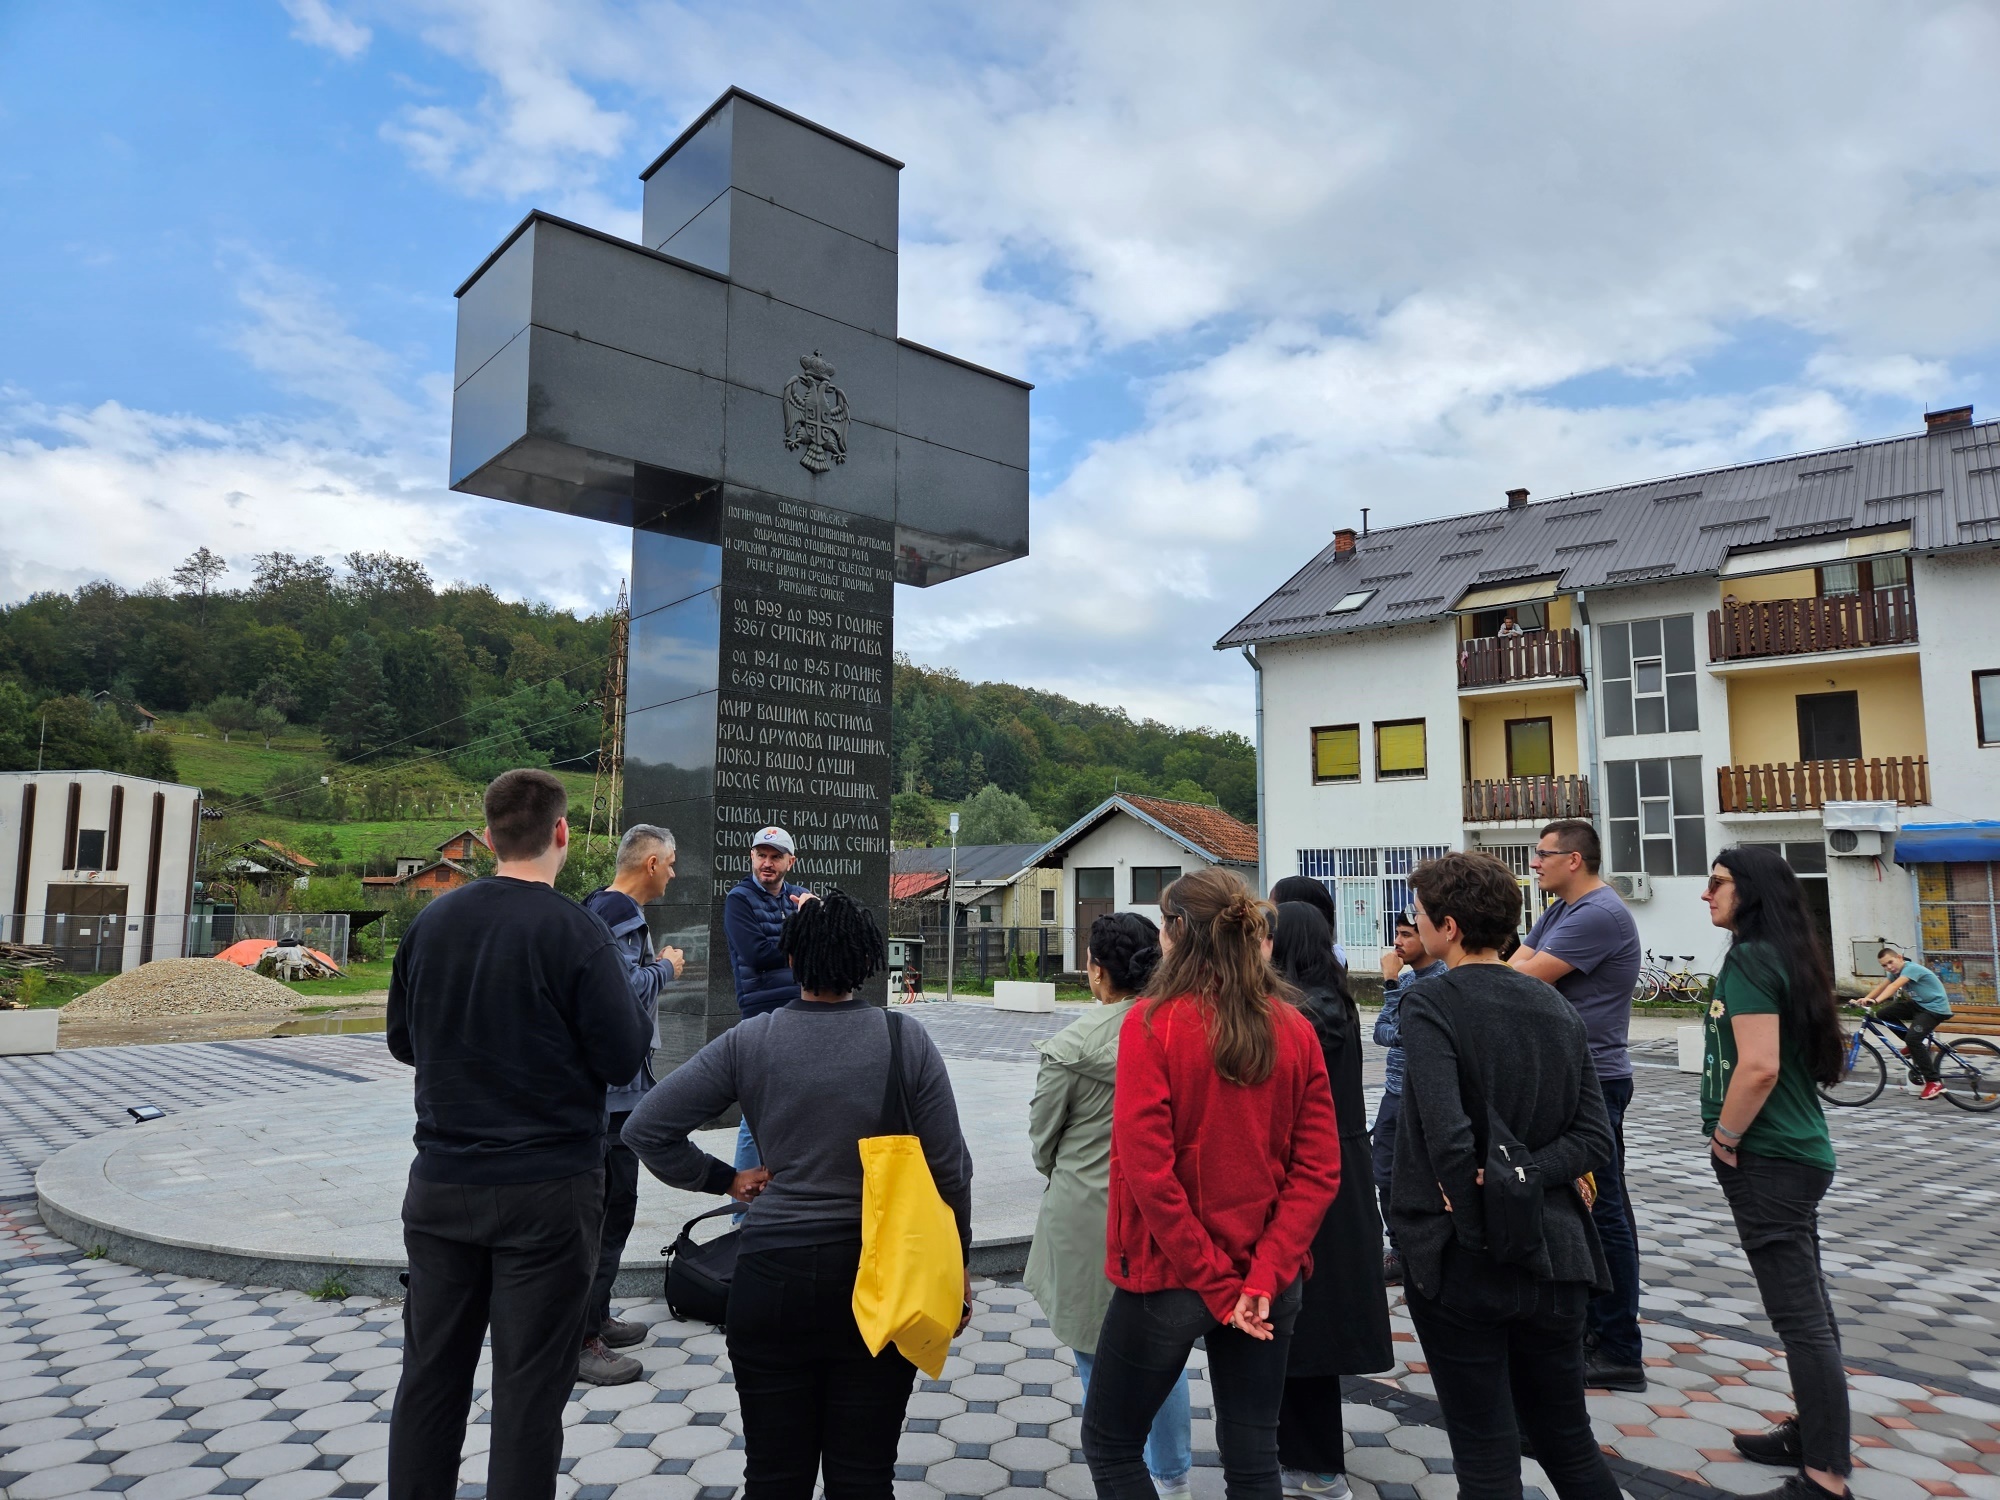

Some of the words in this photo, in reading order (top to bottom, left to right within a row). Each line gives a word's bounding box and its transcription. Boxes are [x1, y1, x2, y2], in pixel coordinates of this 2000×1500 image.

[778, 502, 807, 518] СПОМЕН
[728, 506, 772, 526] ПОГИНУЛИМ
[775, 516, 809, 534] БОРЦИМА
[811, 525, 817, 536] И
[857, 536, 892, 552] ЖРТВАМА
[725, 537, 731, 549] И
[733, 539, 767, 556] СРПСКИМ
[770, 547, 807, 564] ЖРТВАМА
[810, 555, 836, 570] ДРУГОГ
[876, 568, 893, 581] РАТА
[851, 549, 869, 562] РАТА
[776, 563, 799, 578] БИРАЧ
[801, 568, 806, 580] И
[778, 580, 818, 597] РЕПУБЛИКЕ
[820, 588, 845, 602] СРПСКЕ
[755, 599, 782, 619] 1992
[808, 609, 832, 627] 1995
[837, 614, 883, 636] ГОДИНЕ
[733, 617, 766, 638] 3267
[770, 623, 826, 648] СРПСКИХ
[831, 634, 883, 656] ЖРТАВА
[754, 650, 779, 669] 1941
[804, 658, 830, 676] 1945
[835, 662, 882, 684] ГОДИНЕ
[731, 668, 765, 688] 6469
[769, 674, 825, 697] СРПСКИХ
[830, 682, 882, 704] ЖРТАВА
[720, 699, 752, 718] МИР
[757, 703, 809, 725] ВАШИМ
[814, 711, 873, 733] КОСТИМА
[718, 723, 753, 742] КРАЈ
[759, 728, 823, 750] ДРУМОВА
[828, 735, 890, 758] ПРАШНИХ,
[717, 746, 760, 767] ПОКОЈ
[765, 751, 812, 772] ВАШОЈ
[817, 757, 855, 776] ДУШИ
[716, 770, 760, 790] ПОСЛЕ
[766, 775, 804, 794] МУКА
[810, 779, 879, 800] СТРАШНИХ.
[716, 805, 788, 826] СПАВАЈТЕ
[793, 810, 827, 828] КРАЈ
[832, 812, 879, 831] ДРУМА
[846, 836, 888, 856] СЕНКИ,
[792, 858, 862, 875] МЛАДИЋИ
